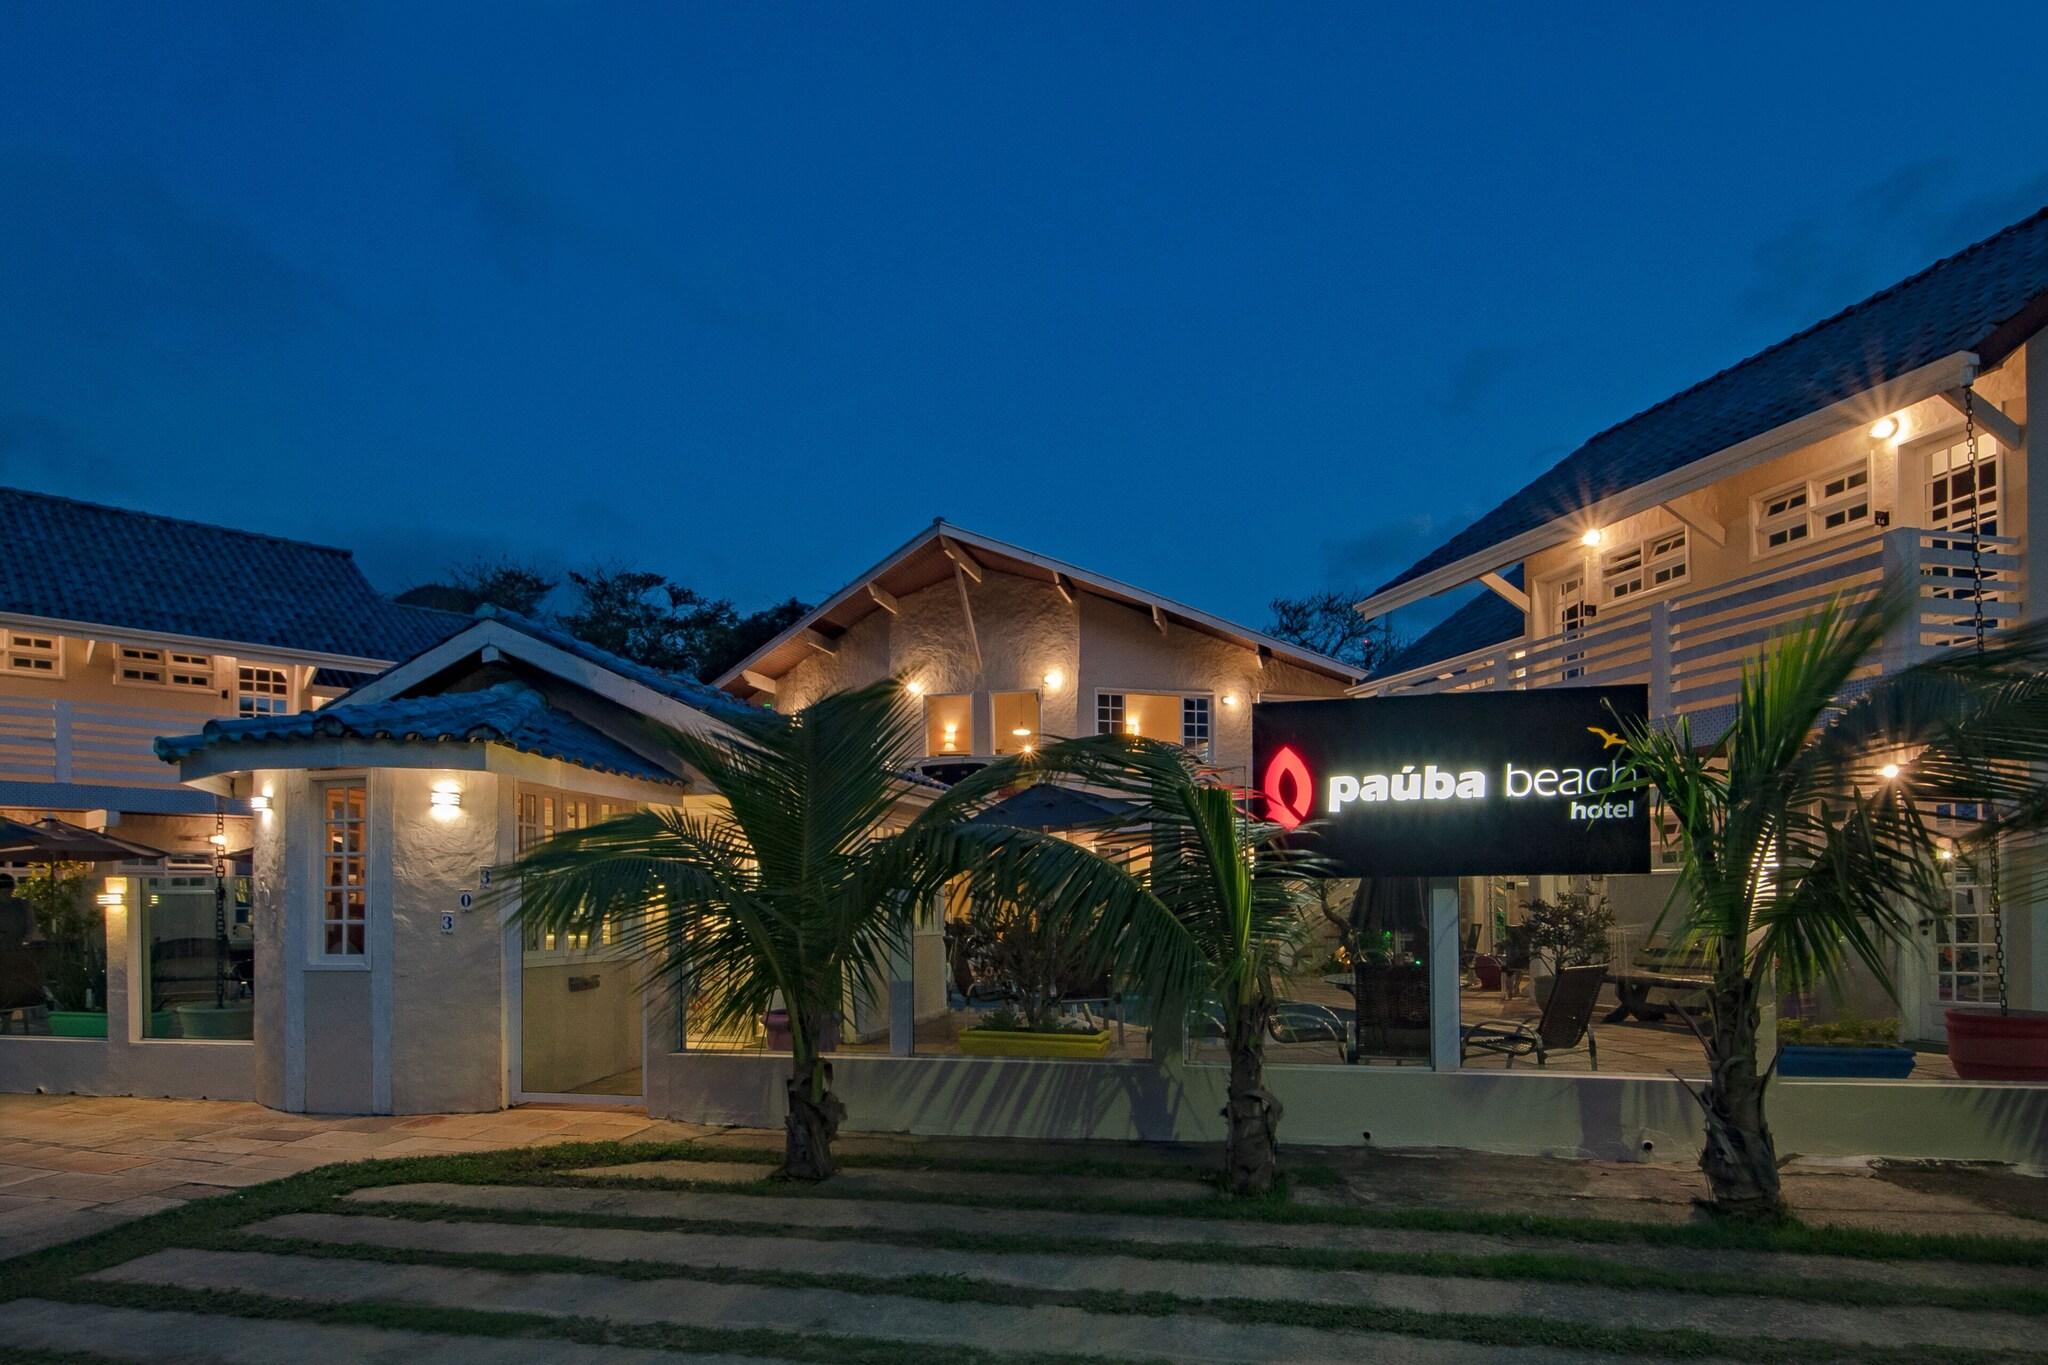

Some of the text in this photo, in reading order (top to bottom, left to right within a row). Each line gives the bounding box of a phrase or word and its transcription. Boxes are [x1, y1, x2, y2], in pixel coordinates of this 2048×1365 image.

[1328, 759, 1637, 813] paúba beach
[1570, 800, 1634, 820] hotel
[442, 915, 453, 930] 3
[460, 893, 472, 908] 0
